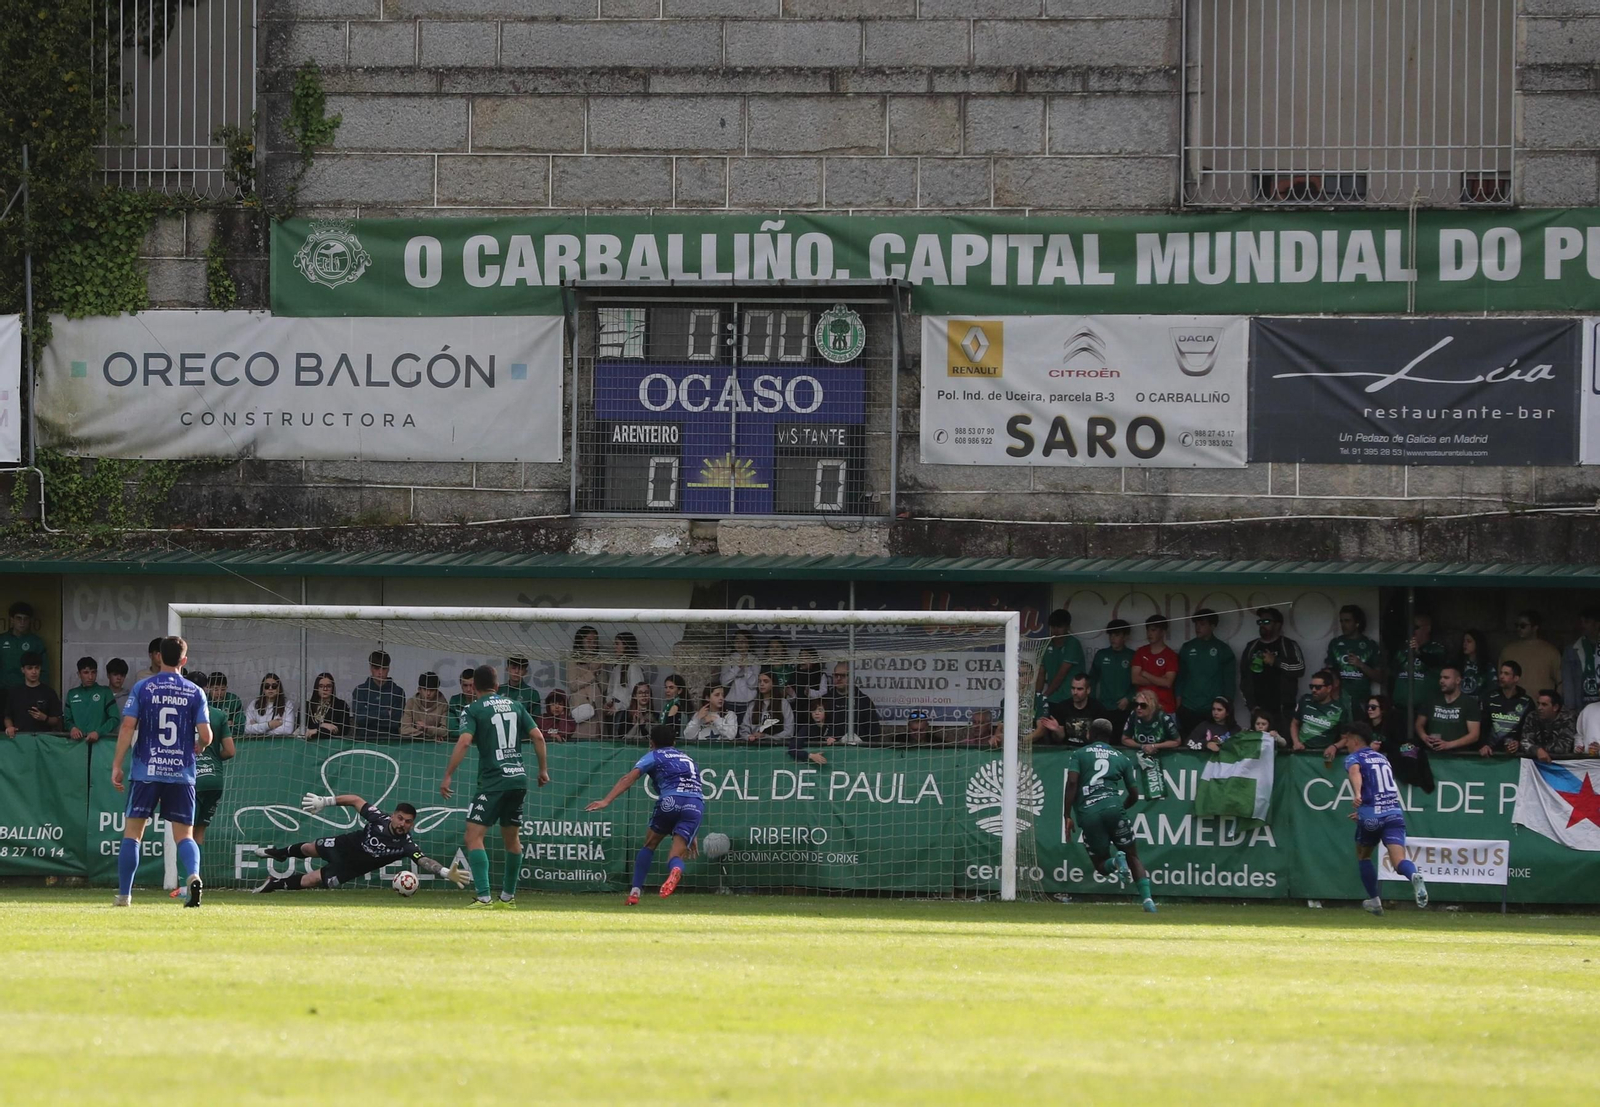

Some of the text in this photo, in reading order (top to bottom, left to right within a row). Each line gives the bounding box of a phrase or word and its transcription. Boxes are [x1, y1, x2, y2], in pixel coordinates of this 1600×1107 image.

[404, 234, 443, 288] O
[868, 231, 1115, 286] CAPITAL
[1136, 229, 1418, 285] MUNDIAL
[1439, 227, 1522, 282] DO
[1178, 334, 1215, 343] DACIA
[103, 344, 495, 388] ORECO BALGÓN
[952, 366, 999, 375] RENAULT
[638, 372, 824, 414] OCASO
[937, 390, 1115, 404] Pol. Ind. de Uceira, parcela B-3
[1135, 390, 1231, 404] O CARBALLIÑO
[180, 411, 417, 427] CONSTRUCTORA
[1364, 405, 1555, 419] restaurante-bar
[612, 425, 679, 444] ARENTEIRO
[778, 427, 845, 445] VISTANTE
[981, 437, 993, 445] 922
[1005, 414, 1166, 459] SARO
[1194, 429, 1207, 437] 988
[1227, 430, 1235, 438] 17
[1339, 433, 1489, 444] Un Pedazo de Galicia en Madrid
[73, 585, 160, 631] CASA
[932, 658, 959, 672] DE
[854, 676, 949, 690] ALUMINIO
[966, 677, 1005, 691] INO
[162, 695, 188, 706] PRADO
[1303, 714, 1332, 727] columbia
[1491, 712, 1520, 721] columbia
[158, 706, 178, 746] 5
[491, 712, 517, 749] 17
[149, 757, 184, 767] ABANCA
[679, 757, 697, 779] 7
[1089, 758, 1110, 786] 2
[1371, 764, 1398, 793] 10
[644, 768, 759, 800] CSAL
[771, 769, 818, 800] DE
[829, 771, 943, 805] PAULA
[1437, 781, 1484, 814] DE
[750, 826, 828, 845] RIBEIRO
[11, 846, 28, 857] 27
[31, 846, 46, 857] 10
[50, 847, 65, 857] 14
[811, 852, 824, 863] DE
[827, 852, 859, 864] ORIXE
[1406, 846, 1505, 866] VERSUS
[534, 868, 607, 883] Carballiño)
[1053, 859, 1084, 883] de
[1417, 866, 1495, 877] E-LEARNING
[1508, 868, 1531, 878] RIXE
